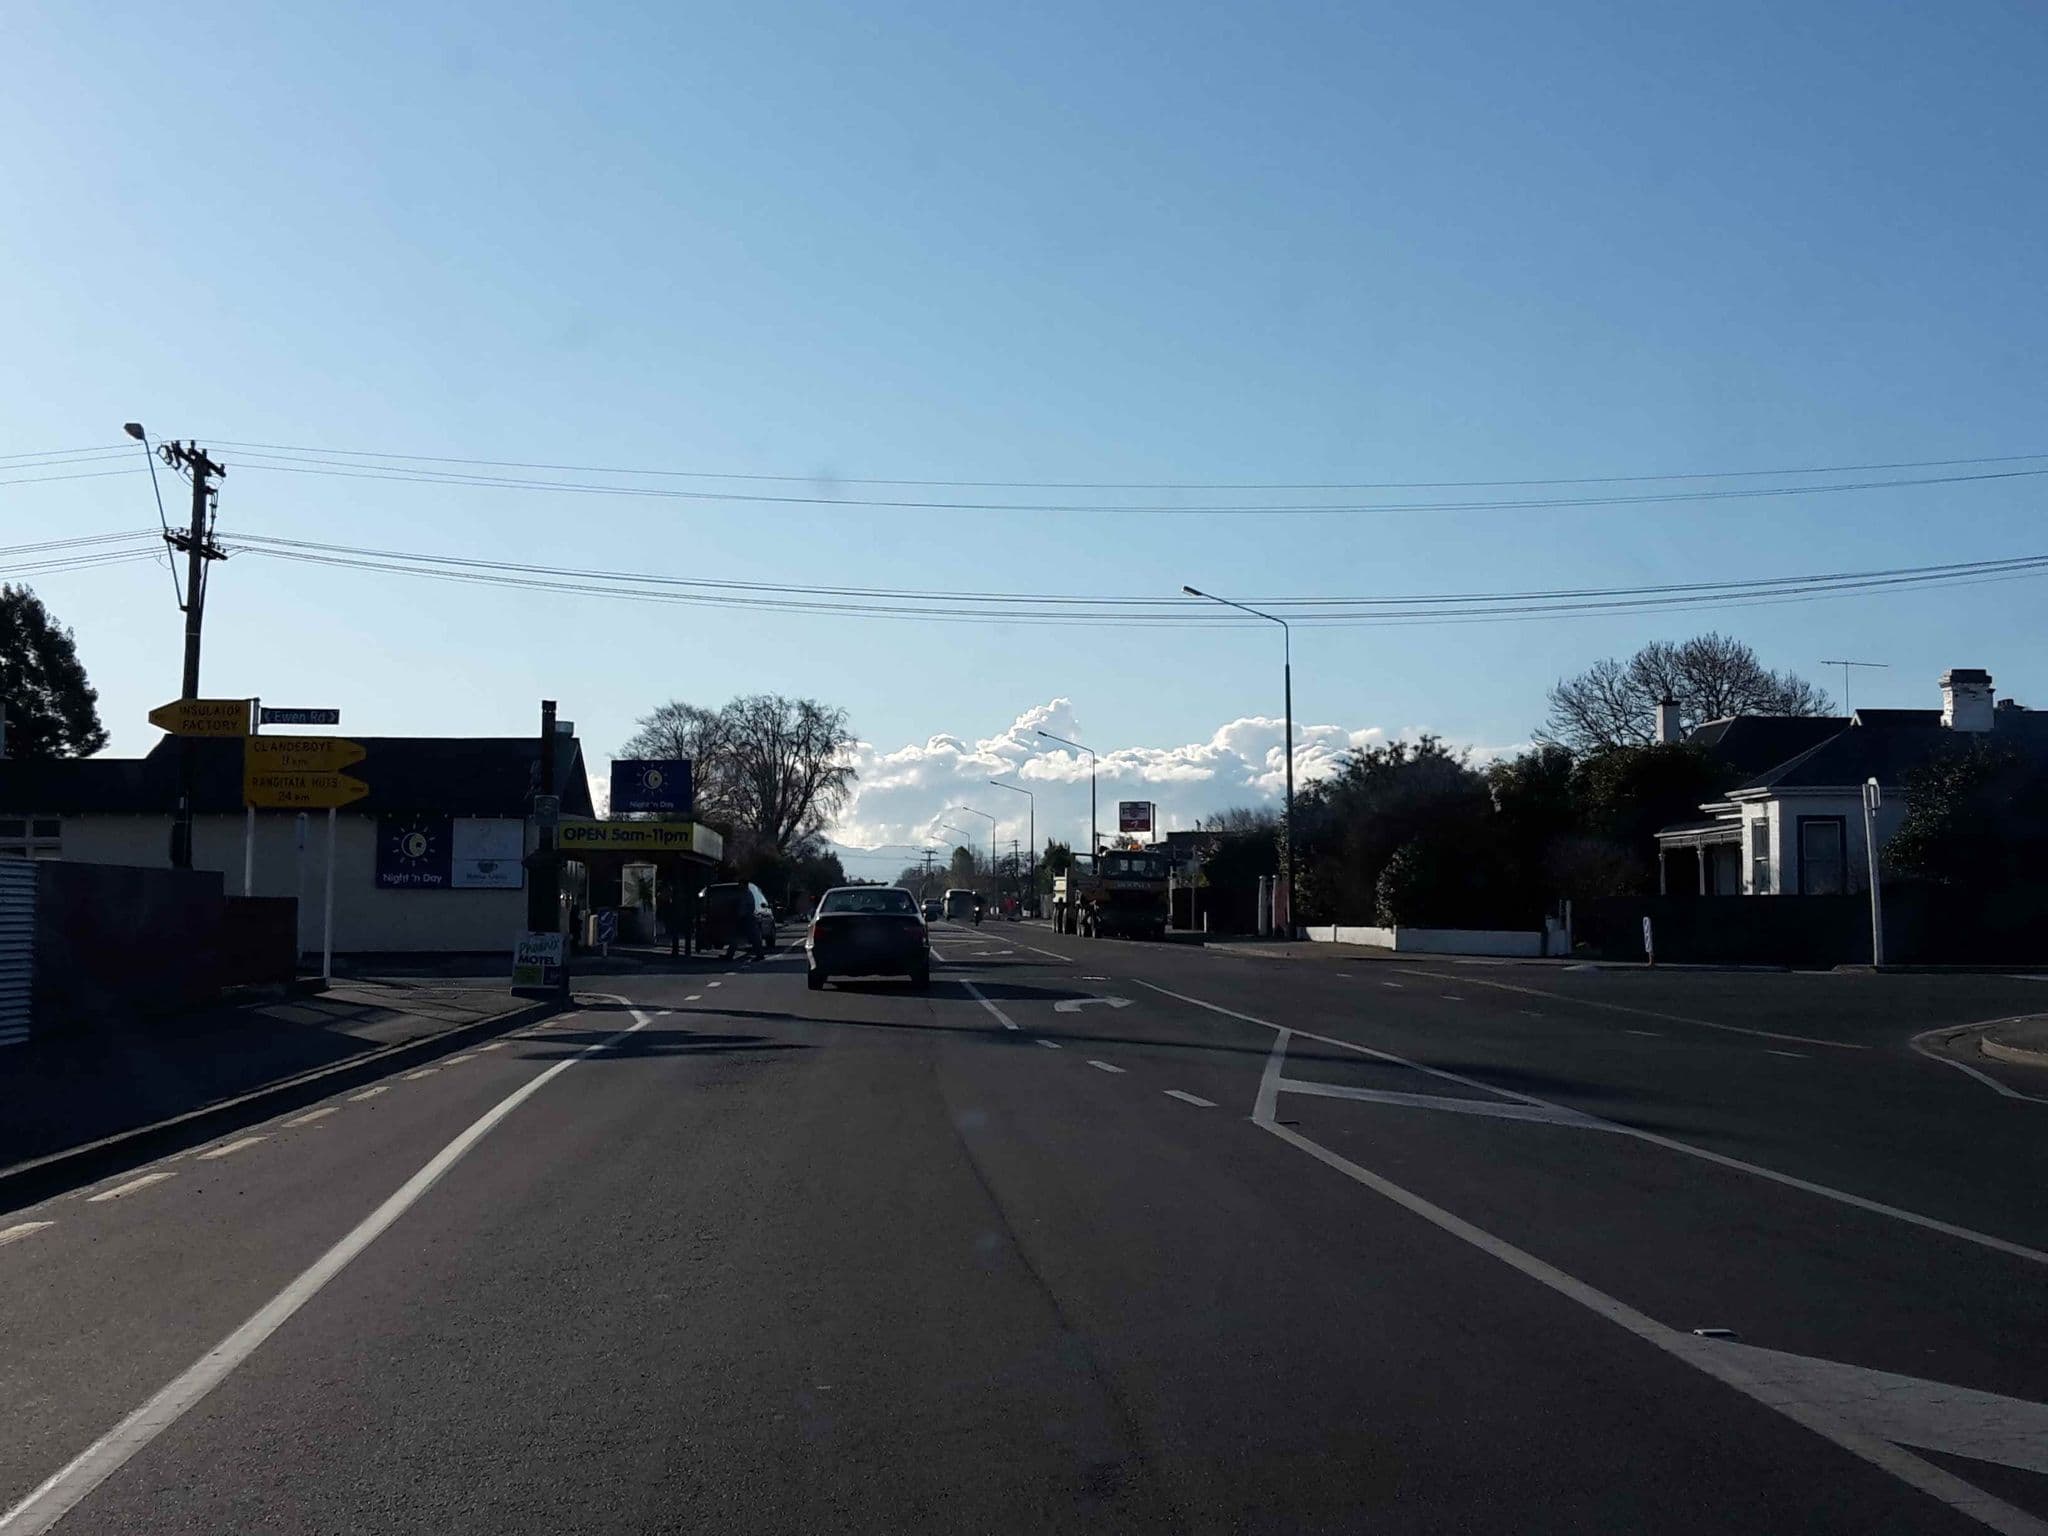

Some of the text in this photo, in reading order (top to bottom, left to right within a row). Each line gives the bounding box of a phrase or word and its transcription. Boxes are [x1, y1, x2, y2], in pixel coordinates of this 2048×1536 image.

[180, 704, 240, 715] INSULATOR
[183, 720, 240, 731] FACTORY
[254, 742, 335, 752] CLANDEBOYE
[252, 777, 305, 787] RANGITATA
[564, 827, 689, 845] OPEN 5am-11pm
[383, 873, 409, 885] Night
[423, 874, 443, 885] Day
[518, 955, 555, 965] MOTEL
